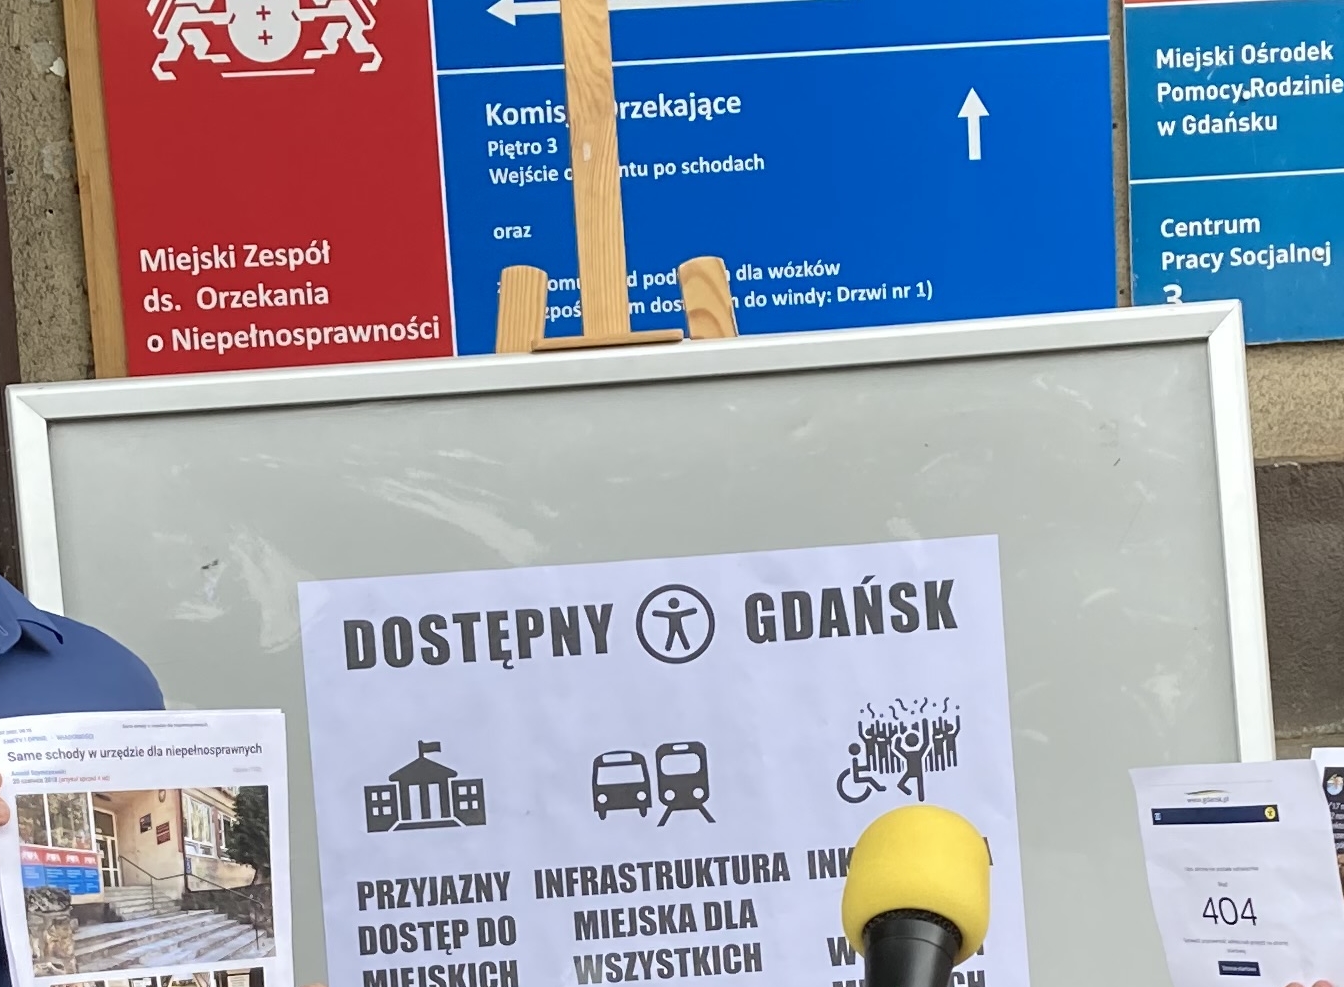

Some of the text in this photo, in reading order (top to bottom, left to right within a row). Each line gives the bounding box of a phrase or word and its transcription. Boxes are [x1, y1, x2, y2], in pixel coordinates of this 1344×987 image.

[1157, 41, 1334, 72] Miejski Ośrodek
[1158, 75, 1344, 103] Pomocy Rodzinie
[485, 92, 741, 127] Komis rzekające
[1158, 112, 1277, 136] w Gdańsku
[488, 138, 557, 159] Piętro 3
[489, 165, 558, 187] Wejście
[654, 161, 676, 179] po
[681, 154, 764, 174] schodach
[493, 225, 532, 239] oraz
[1160, 217, 1260, 238] Centrum
[140, 240, 330, 276] Miejski Zespół
[736, 264, 763, 281] dla
[768, 259, 840, 279] wózków
[1161, 241, 1331, 272] Pracy Socjalnej
[144, 281, 329, 312] ds. Orzekania
[745, 291, 767, 308] do
[772, 287, 831, 307] windy:
[837, 283, 886, 302] Drzwi
[892, 286, 910, 298] nr
[916, 280, 932, 300] 1)
[147, 315, 439, 355] o Niepełnosprawności
[344, 575, 958, 670] DOSTĘPNY GDAŃSK
[8, 743, 262, 762] Same schody w urzędzie dla niepełnosprawnych
[357, 871, 511, 911] PRZYJAZNY
[534, 852, 791, 899] INFRASTRUKTURA
[574, 899, 758, 941] MIEJSKA DLA
[1202, 897, 1257, 926] 404
[359, 915, 516, 955] DOSTĘP DO
[573, 942, 763, 985] WSZYSTKICH
